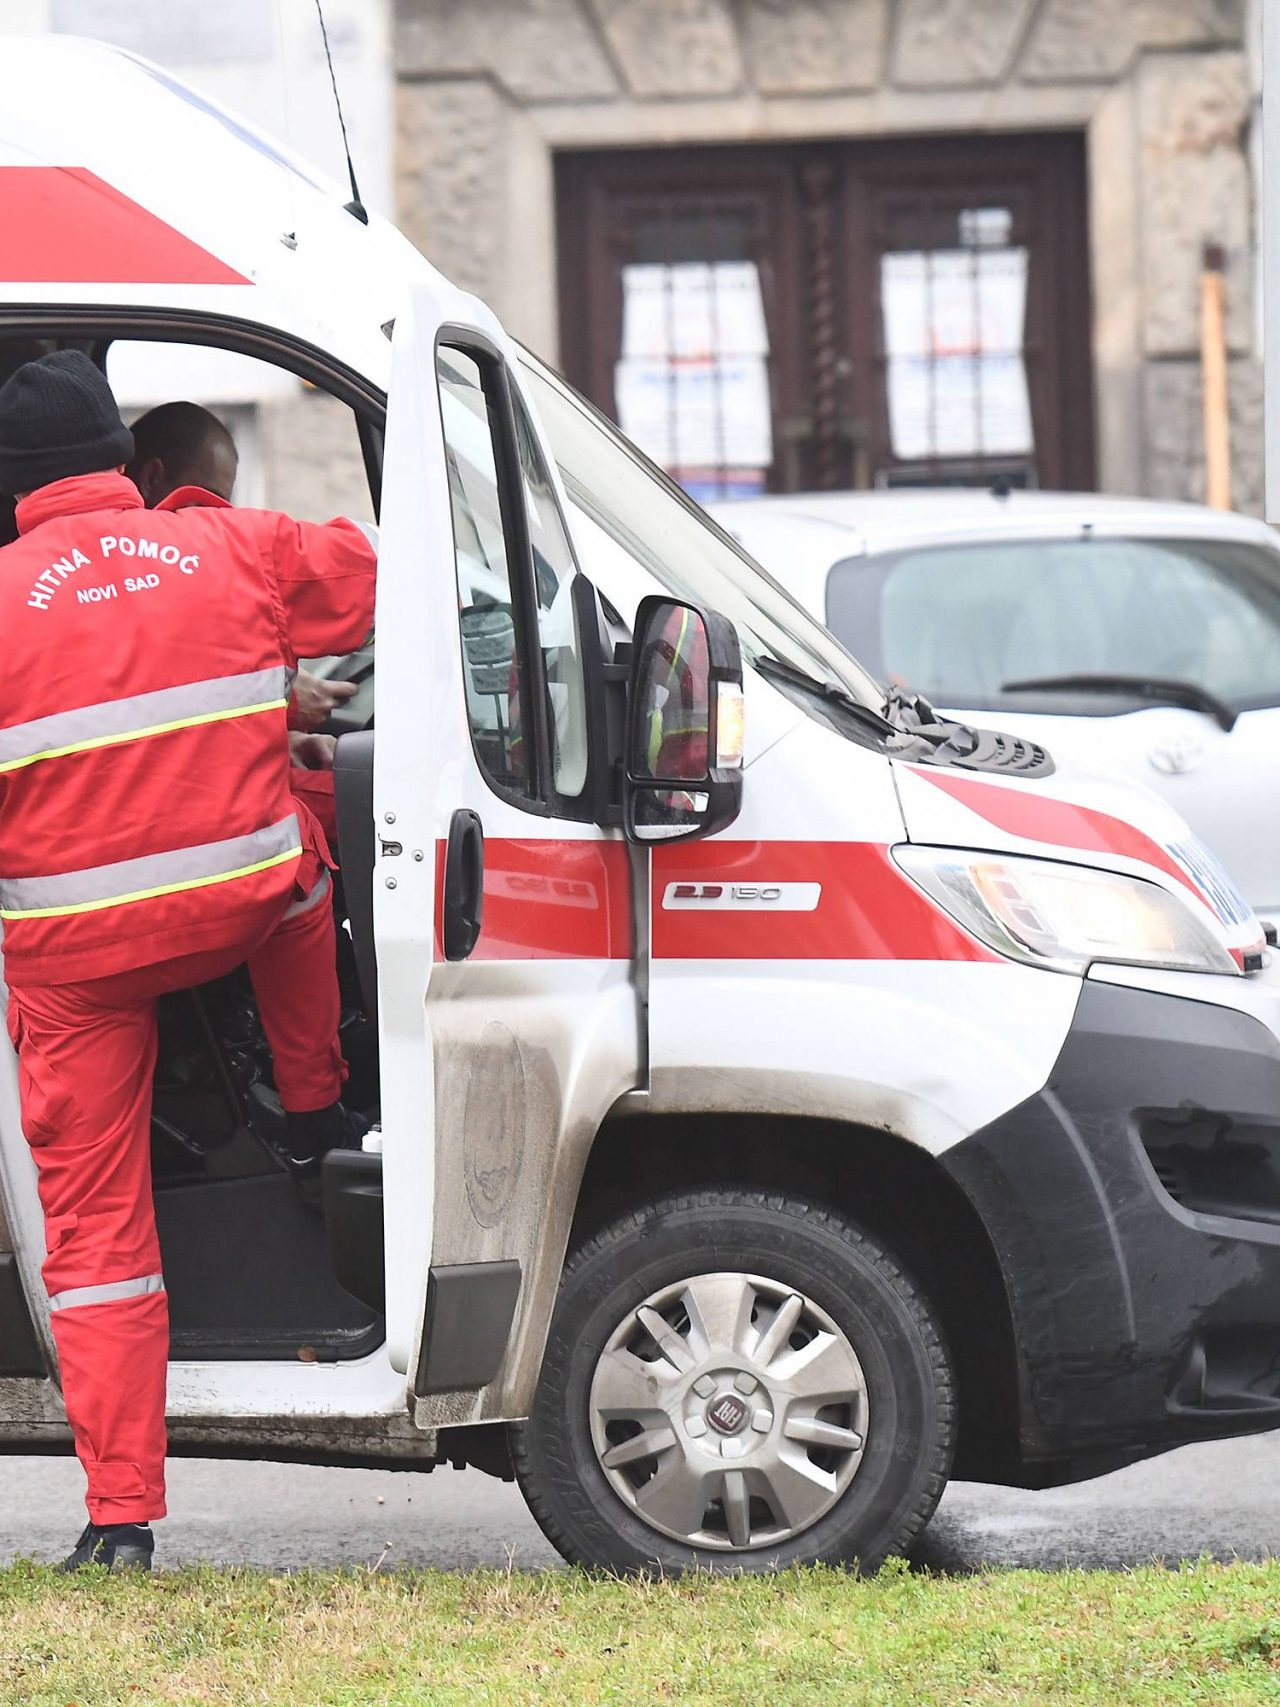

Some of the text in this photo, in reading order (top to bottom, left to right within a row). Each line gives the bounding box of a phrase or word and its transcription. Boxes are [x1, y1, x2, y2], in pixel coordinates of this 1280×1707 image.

[26, 547, 92, 610] HITNA
[76, 573, 160, 604] NOVI SAD
[713, 1400, 742, 1428] FIAT
